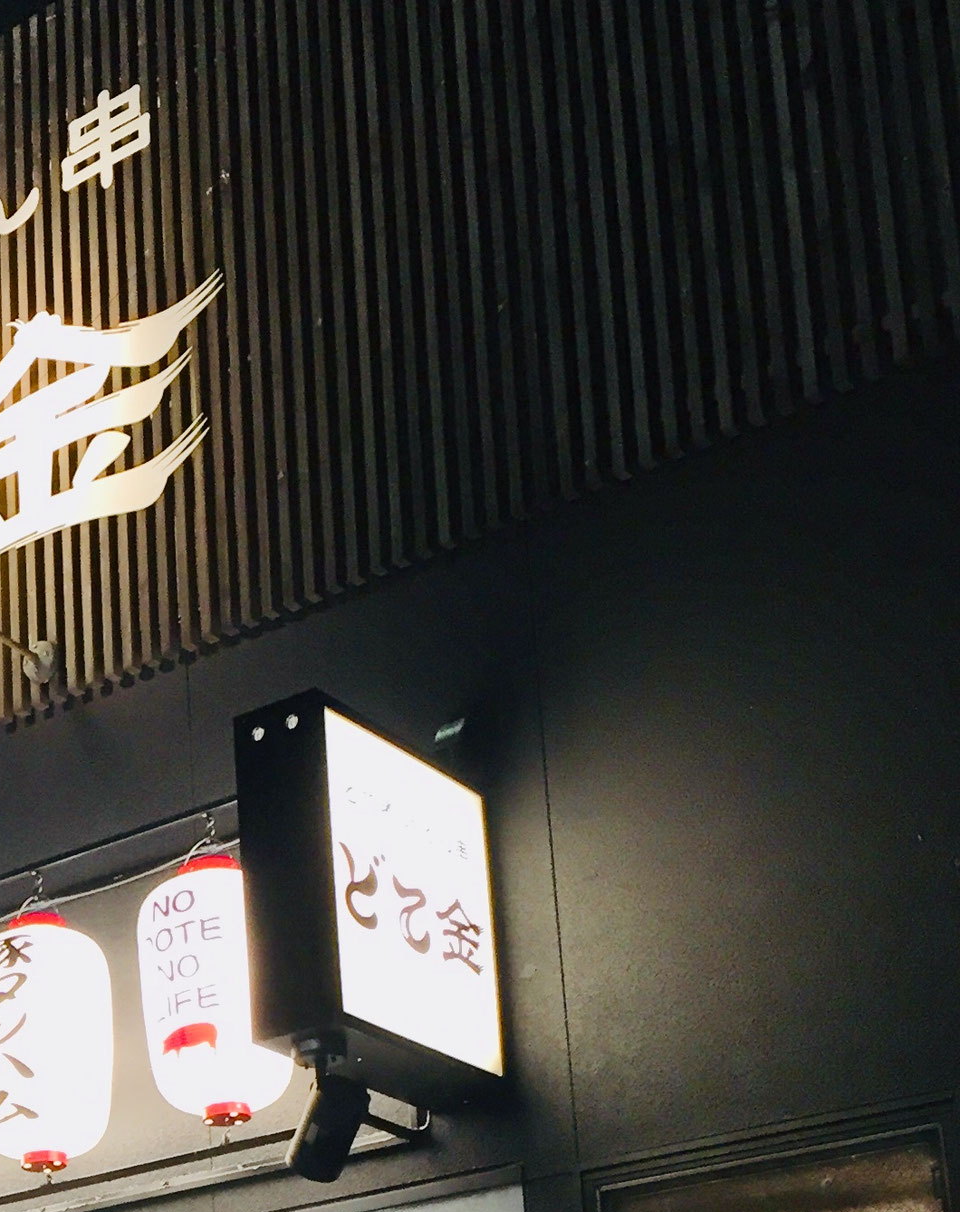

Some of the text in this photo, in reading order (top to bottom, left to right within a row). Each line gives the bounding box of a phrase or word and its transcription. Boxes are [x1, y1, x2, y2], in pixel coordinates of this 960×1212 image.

[151, 889, 195, 922] NO
[339, 841, 485, 976] どて金
[147, 916, 223, 953] OTE
